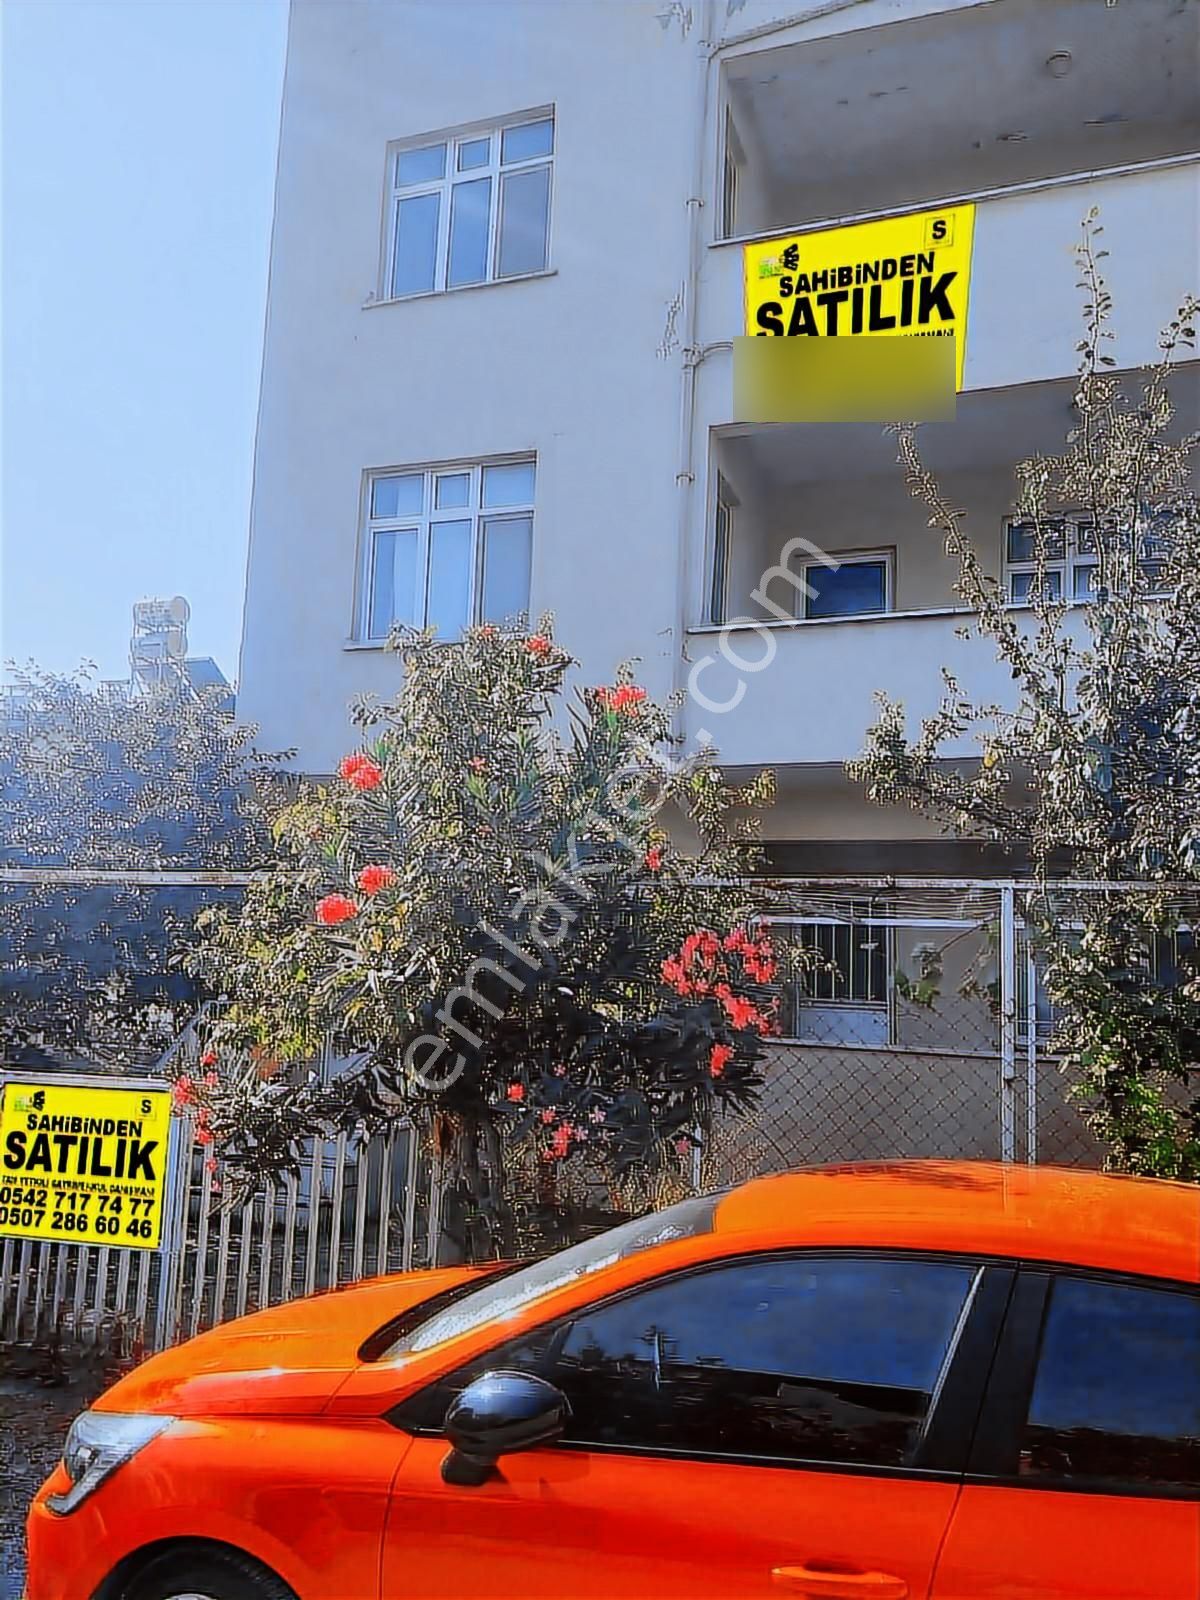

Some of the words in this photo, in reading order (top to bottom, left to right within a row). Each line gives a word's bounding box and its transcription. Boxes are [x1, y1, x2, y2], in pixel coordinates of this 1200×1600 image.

[932, 220, 947, 240] S
[756, 271, 958, 337] SATILIK
[141, 1099, 152, 1114] S
[3, 1130, 159, 1181] SATILIK
[0, 1187, 48, 1208] 0542
[55, 1191, 91, 1211] 717
[98, 1195, 123, 1214] 74
[130, 1198, 155, 1217] 77
[0, 1206, 46, 1228] 0507
[51, 1211, 88, 1232] 286
[95, 1216, 120, 1235] 60
[126, 1219, 152, 1239] 46
